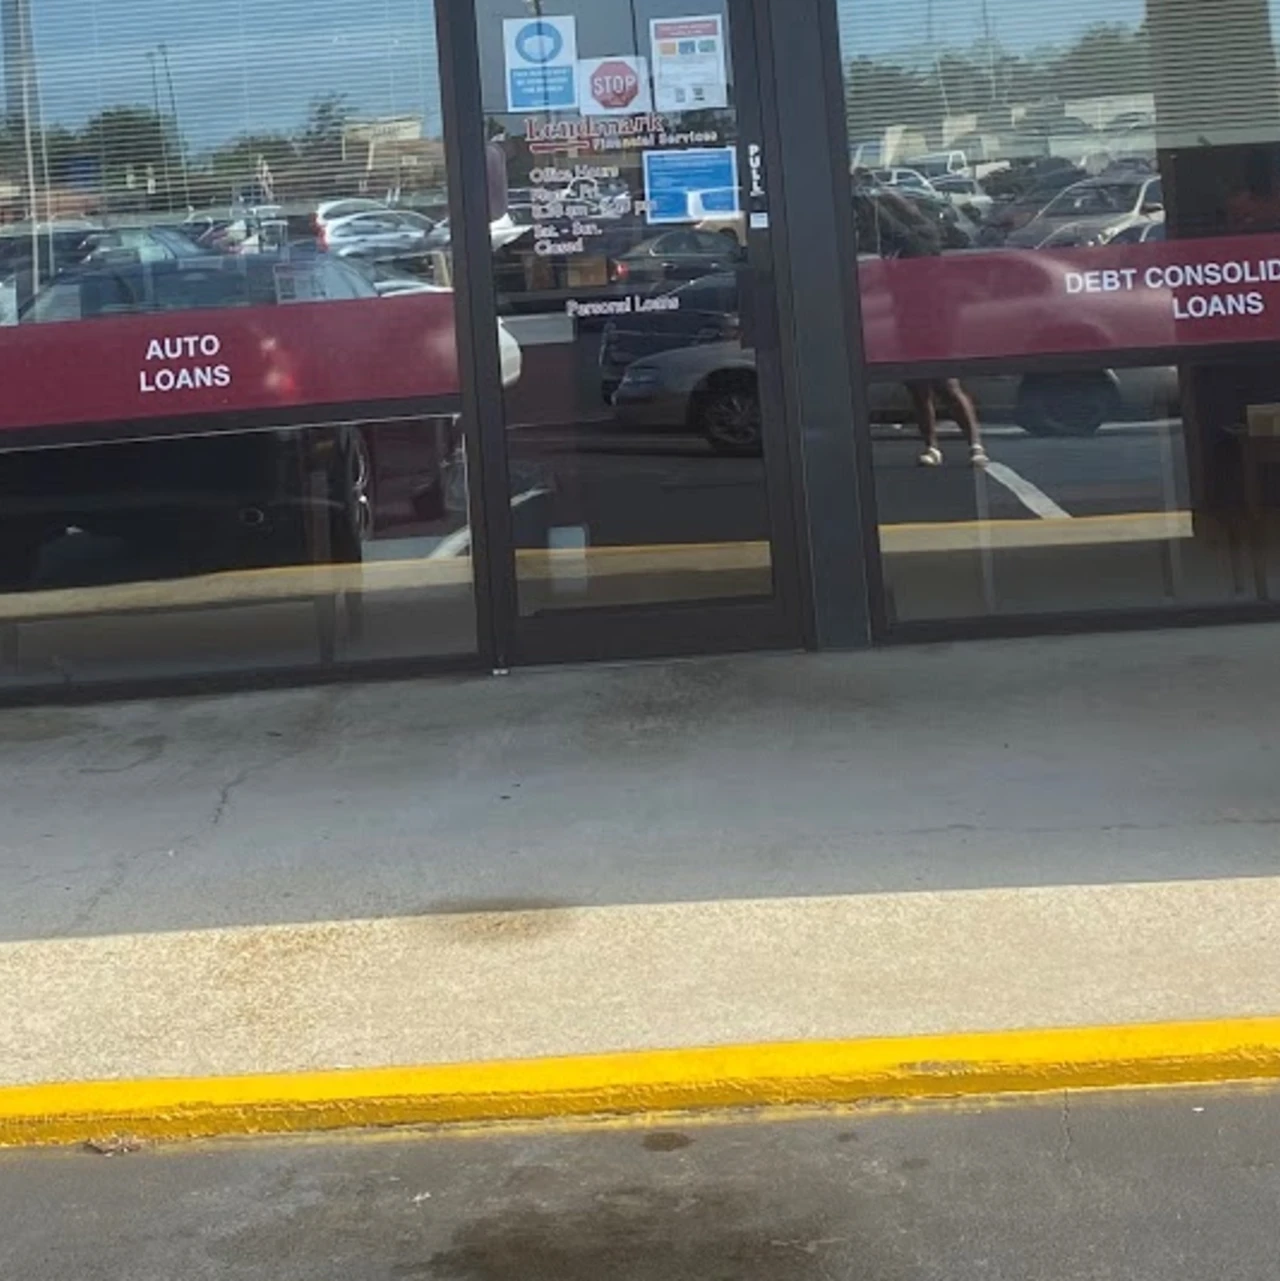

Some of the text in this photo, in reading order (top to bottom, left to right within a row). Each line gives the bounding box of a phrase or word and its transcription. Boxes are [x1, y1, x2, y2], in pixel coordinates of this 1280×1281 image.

[593, 75, 634, 96] STOP
[524, 113, 664, 142] Lendmark
[593, 131, 718, 151] Financial Services
[529, 165, 619, 184] Office Hours
[748, 144, 765, 196] PULL
[534, 238, 584, 255] Closed
[1064, 269, 1137, 294] DEBT
[566, 295, 679, 317] Personal Loans
[1172, 292, 1264, 319] LOANS
[145, 334, 221, 360] AUTO
[139, 363, 231, 392] LOANS
